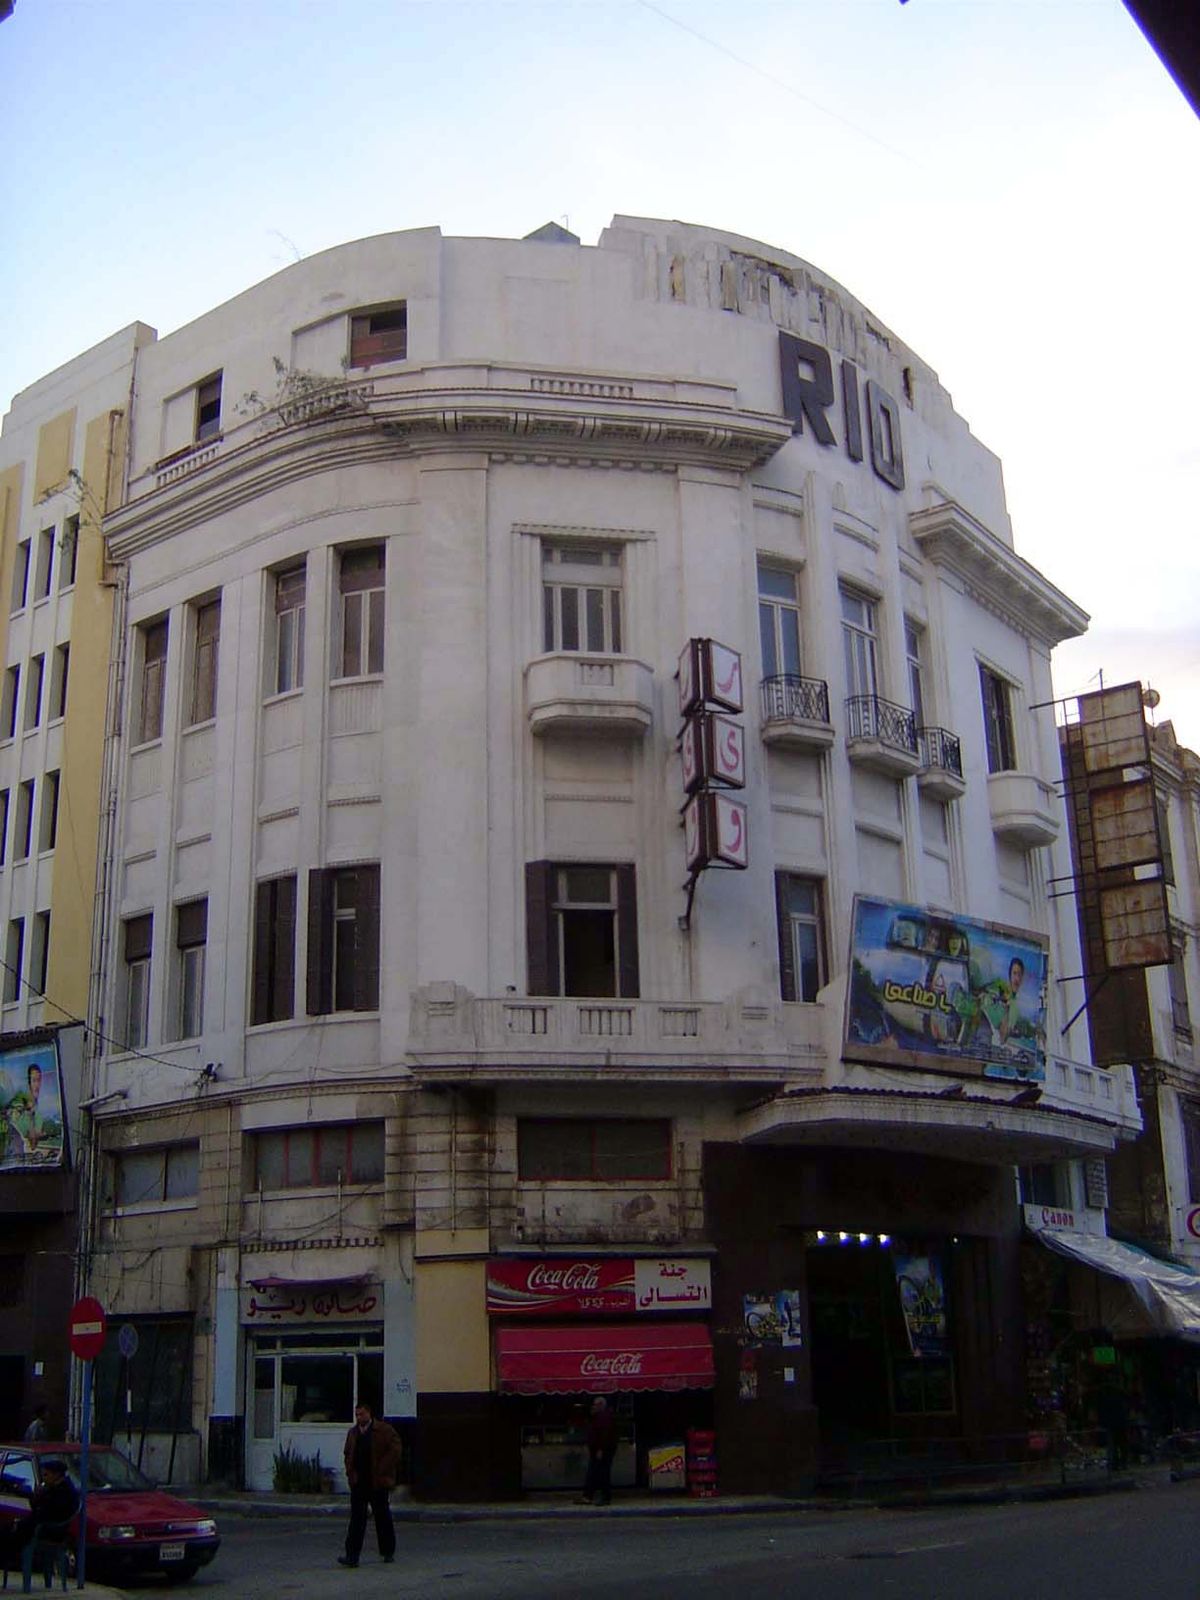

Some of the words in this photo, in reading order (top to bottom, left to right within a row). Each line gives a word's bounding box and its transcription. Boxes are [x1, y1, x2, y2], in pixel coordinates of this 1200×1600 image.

[778, 330, 906, 491] RIO
[1041, 1207, 1075, 1228] Canon
[527, 1263, 603, 1290] Coca-Cola
[659, 1262, 688, 1280] جنة
[247, 1294, 306, 1319] ريو
[312, 1293, 377, 1316] صالون
[580, 1352, 644, 1376] Coca-Cola
